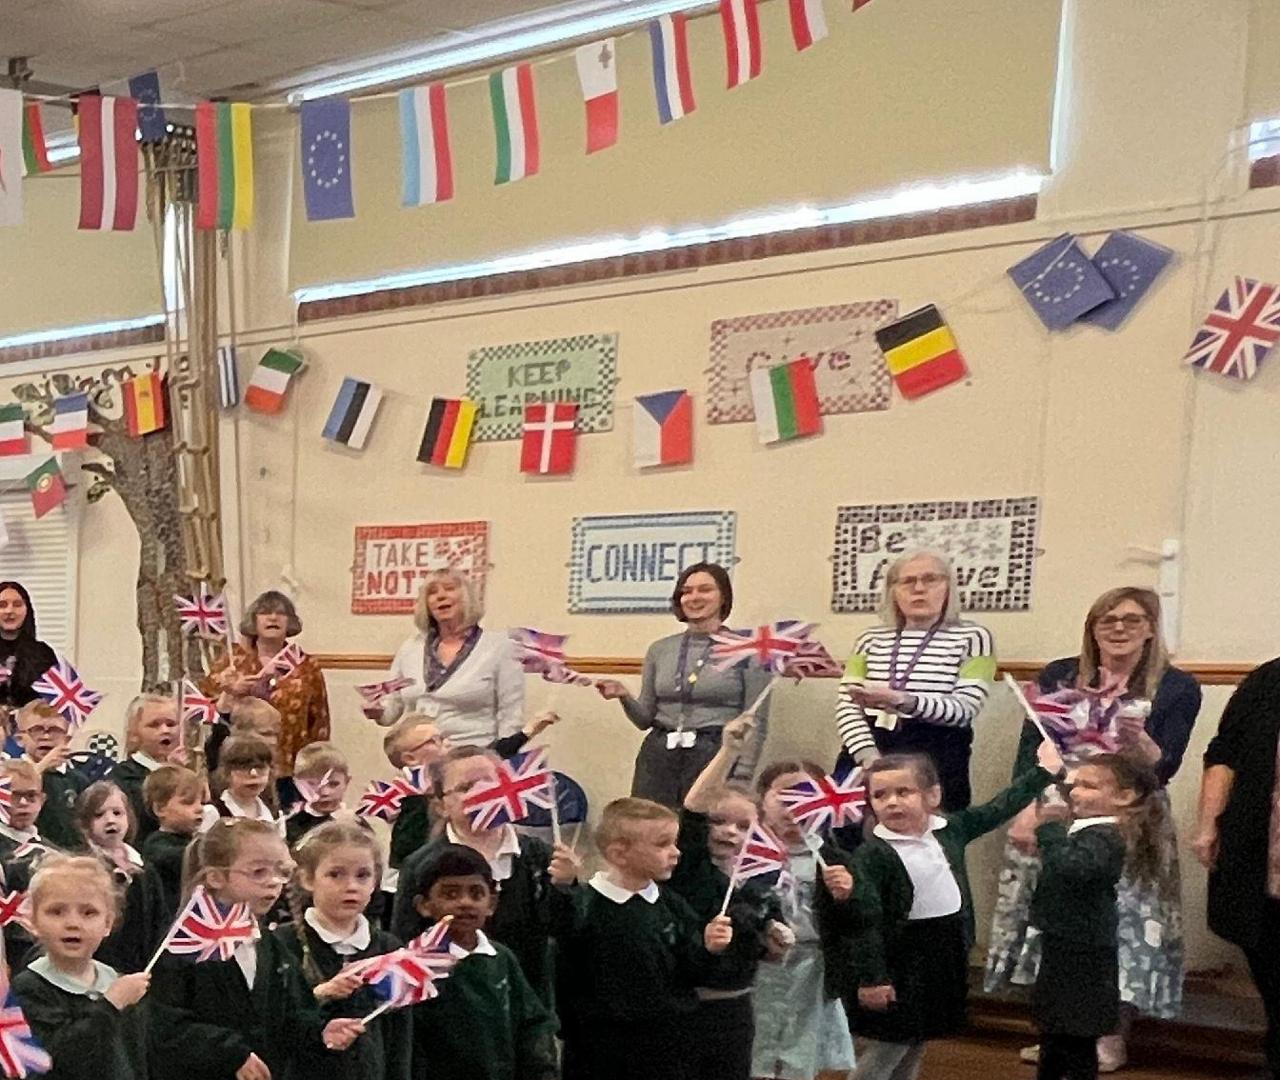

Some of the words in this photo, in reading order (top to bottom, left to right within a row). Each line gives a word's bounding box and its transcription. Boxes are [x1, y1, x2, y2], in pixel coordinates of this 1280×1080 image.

[508, 359, 571, 388] KEEP
[859, 524, 907, 554] Be
[373, 542, 429, 568] TAKE
[586, 541, 716, 584] CONNECT
